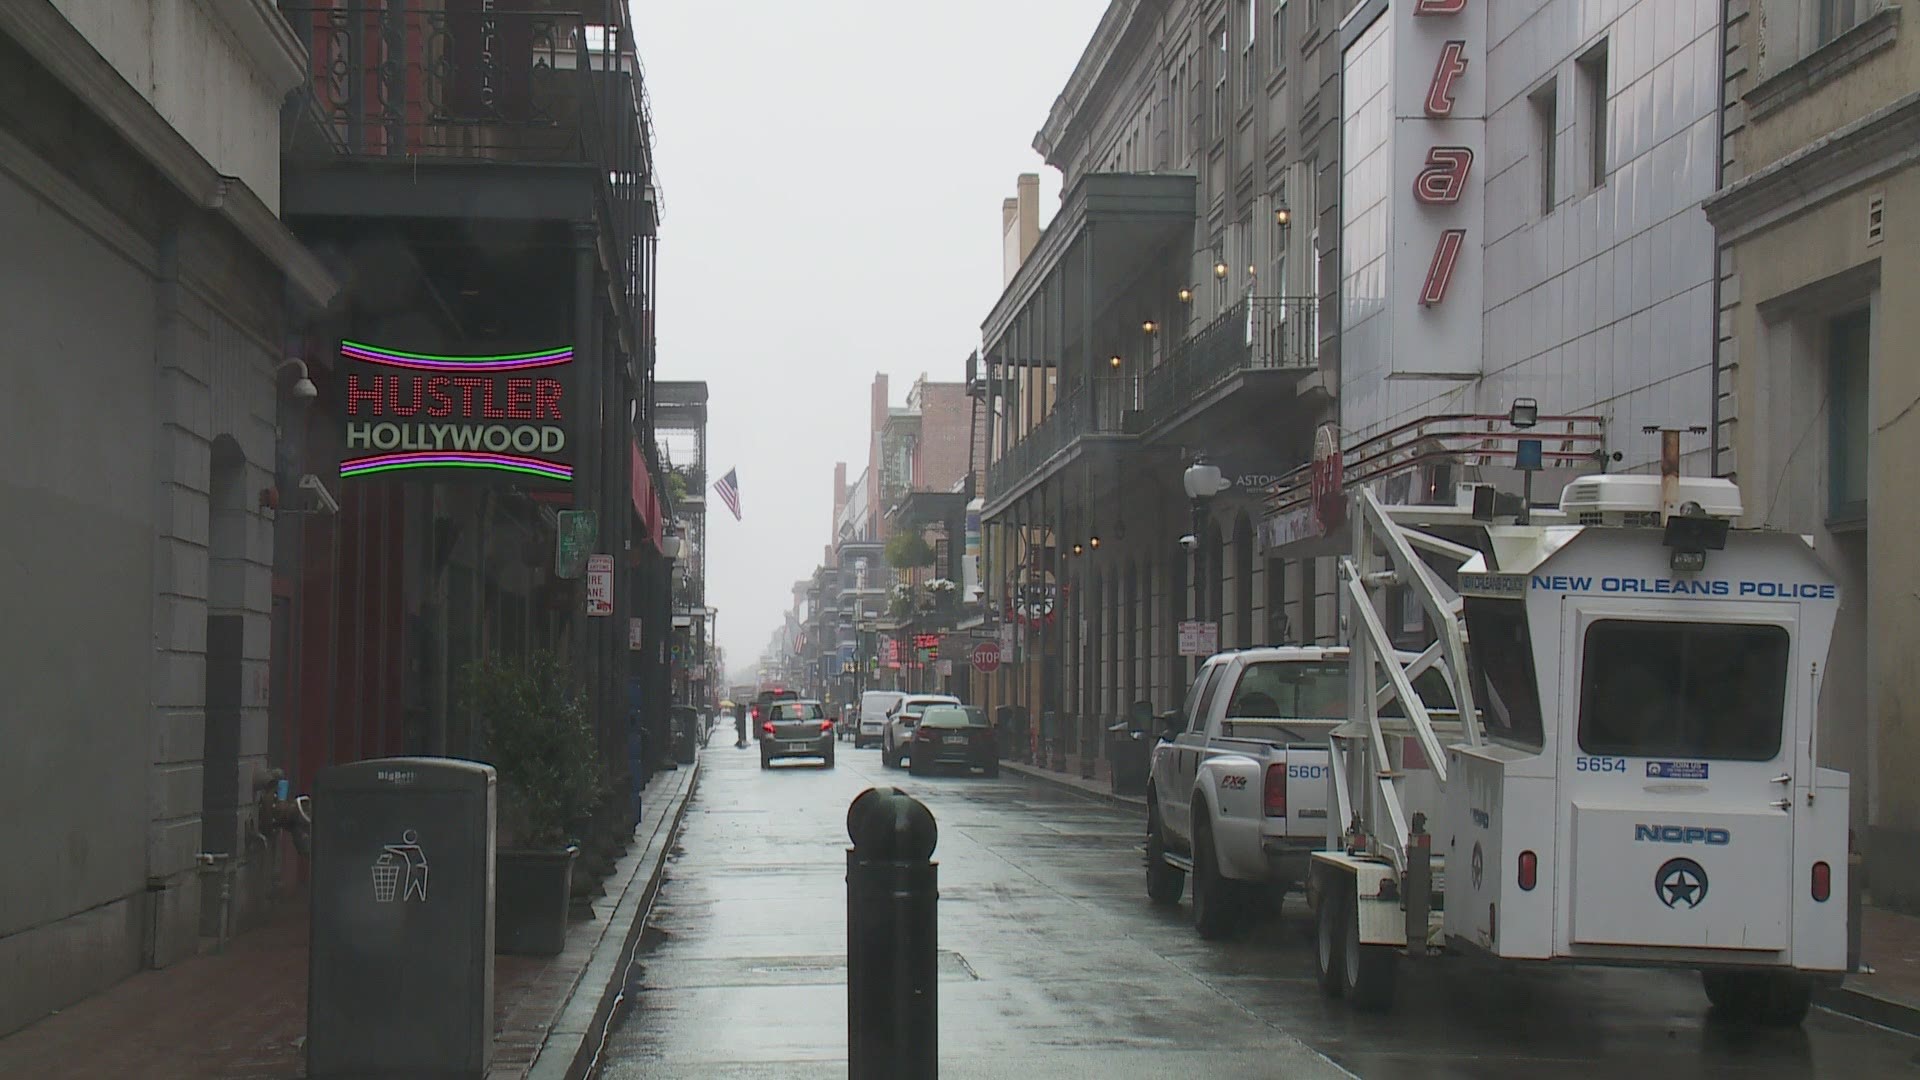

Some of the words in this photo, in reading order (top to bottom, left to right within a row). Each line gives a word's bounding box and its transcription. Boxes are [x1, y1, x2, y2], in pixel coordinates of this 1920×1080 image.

[1413, 0, 1475, 306] tal
[347, 373, 563, 420] HUSTLER
[346, 421, 565, 453] HOLLYWOOD
[588, 575, 603, 585] IRE
[1531, 575, 1592, 591] NEW
[1601, 577, 1729, 596] ORLEANS
[1739, 581, 1836, 599] POLICE
[587, 587, 605, 598] ANE
[975, 652, 1000, 663] STOP
[1288, 765, 1329, 779] 5601
[1576, 757, 1627, 773] 5654
[1634, 823, 1731, 846] NOPD
